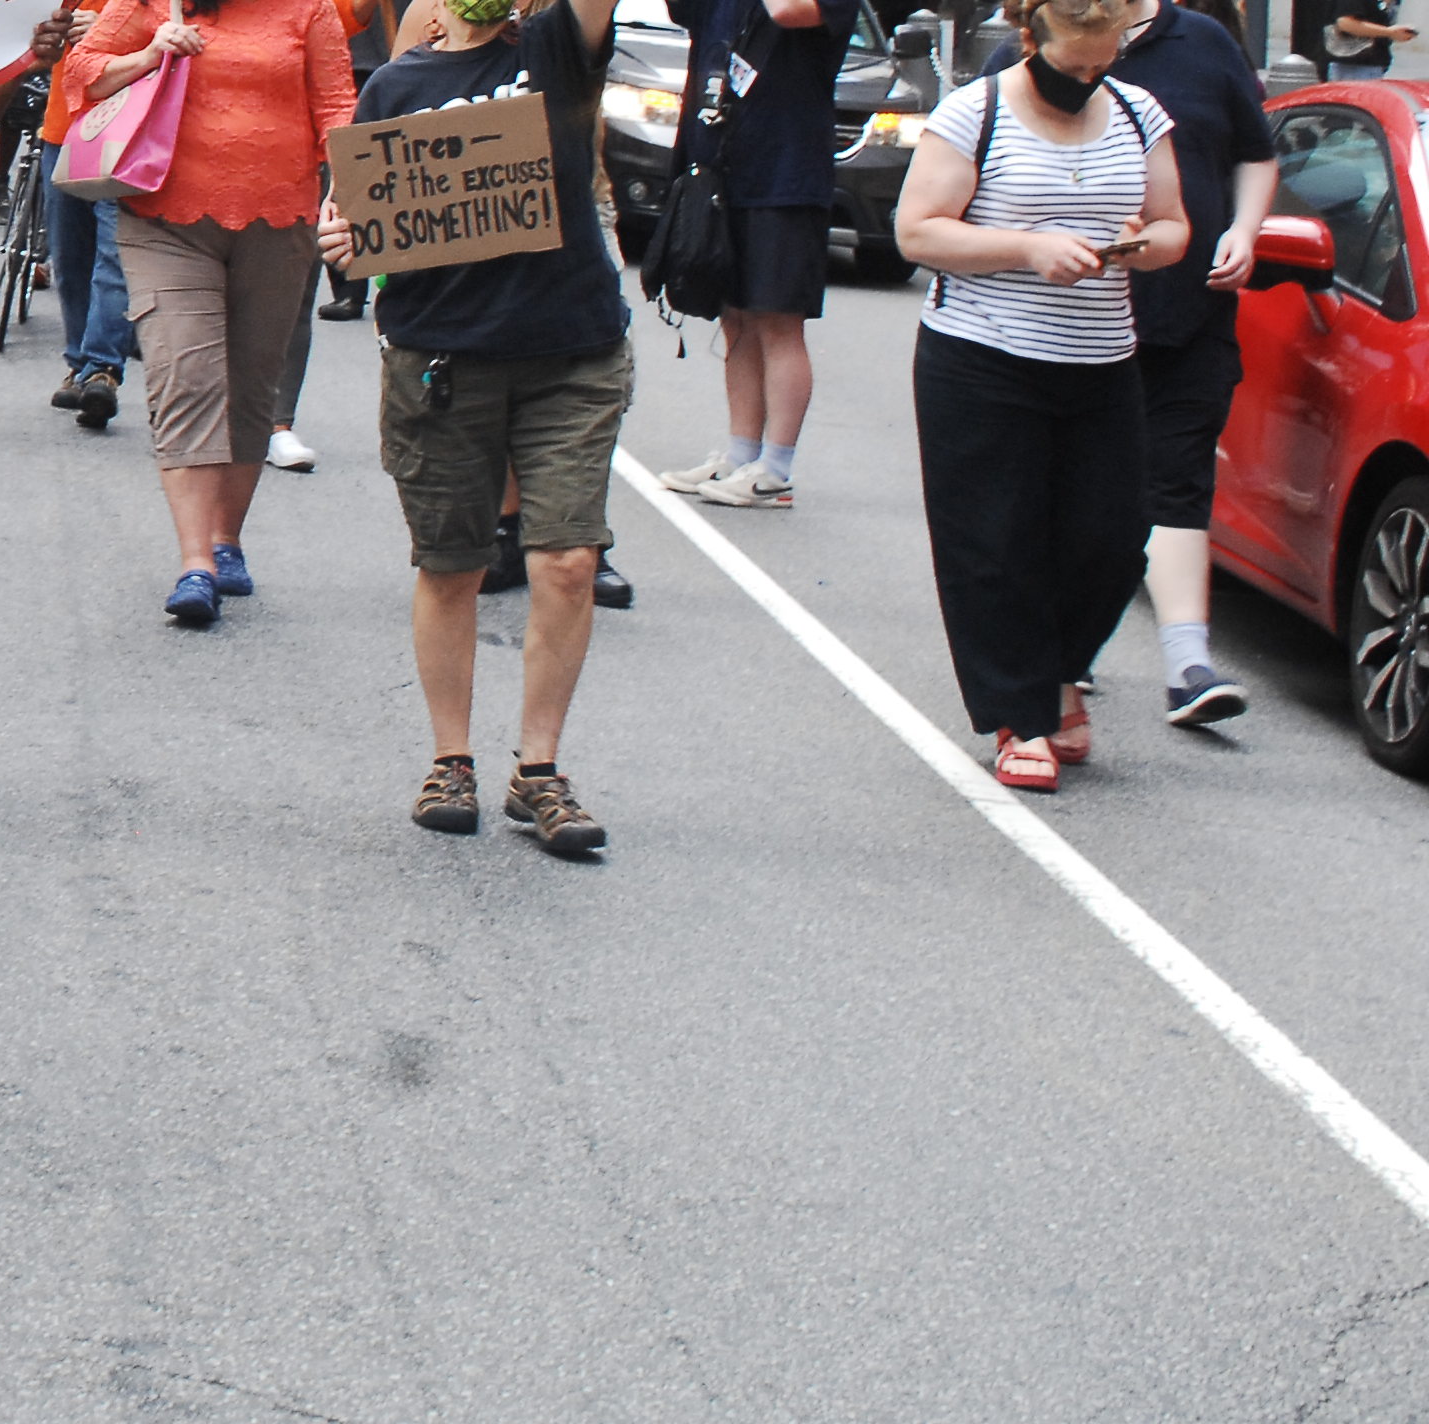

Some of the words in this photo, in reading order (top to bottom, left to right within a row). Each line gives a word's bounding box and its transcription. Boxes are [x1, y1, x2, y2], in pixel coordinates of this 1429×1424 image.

[368, 171, 398, 204] of
[407, 165, 452, 199] the
[349, 218, 384, 258] DO
[393, 188, 552, 251] SOMETHING!
